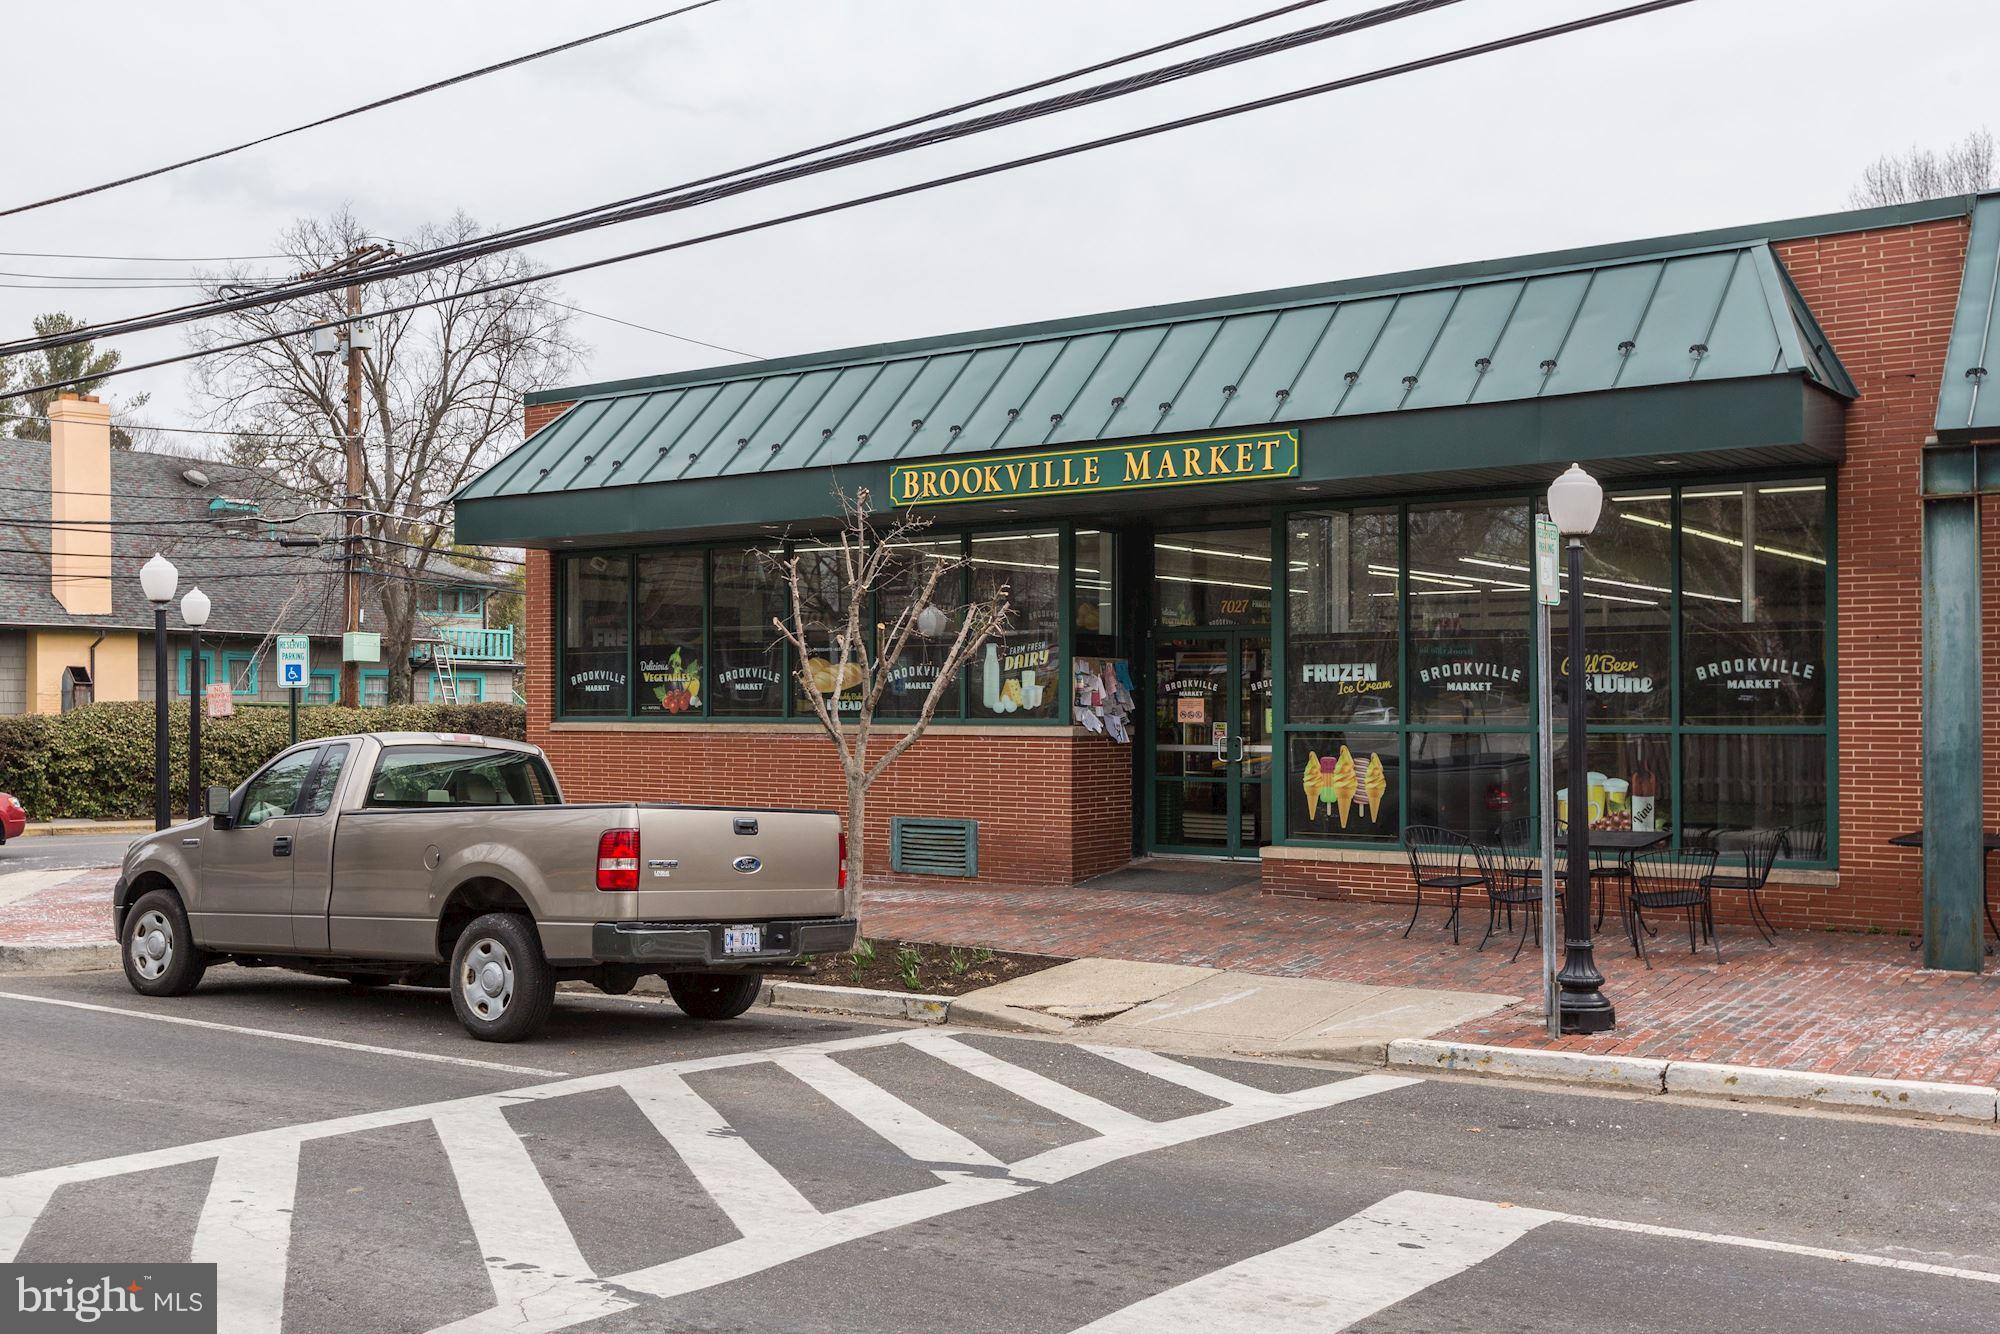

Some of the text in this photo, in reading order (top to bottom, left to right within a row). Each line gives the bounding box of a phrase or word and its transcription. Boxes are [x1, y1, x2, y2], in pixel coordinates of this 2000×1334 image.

[903, 439, 1281, 500] BROOKVILLE MARKET
[1221, 600, 1249, 613] 7027
[279, 640, 307, 649] RESERVED
[1009, 640, 1048, 655] FARM FRESH
[281, 652, 305, 661] PARKING
[1004, 649, 1050, 671] DAIRY
[1599, 654, 1639, 674] Beer
[640, 660, 669, 671] Delicious
[1303, 663, 1377, 683] FROZEN
[1420, 662, 1521, 683] BROOKVILLE
[1696, 658, 1815, 680] BROOKVILLE
[571, 670, 626, 686] BROOKVILLE
[643, 671, 690, 682] VEGETABLES
[719, 667, 780, 684] BROOKVILLE
[1592, 673, 1654, 693] Wine
[585, 684, 611, 692] MARKET
[735, 682, 764, 691] MARKET
[1165, 680, 1219, 692] BROOKVILLE
[1337, 676, 1393, 695] Ice Cream
[1446, 682, 1493, 691] MARKET
[1727, 679, 1781, 689] MARKET
[1633, 803, 1654, 825] Vino
[725, 932, 757, 947] CM 8731
